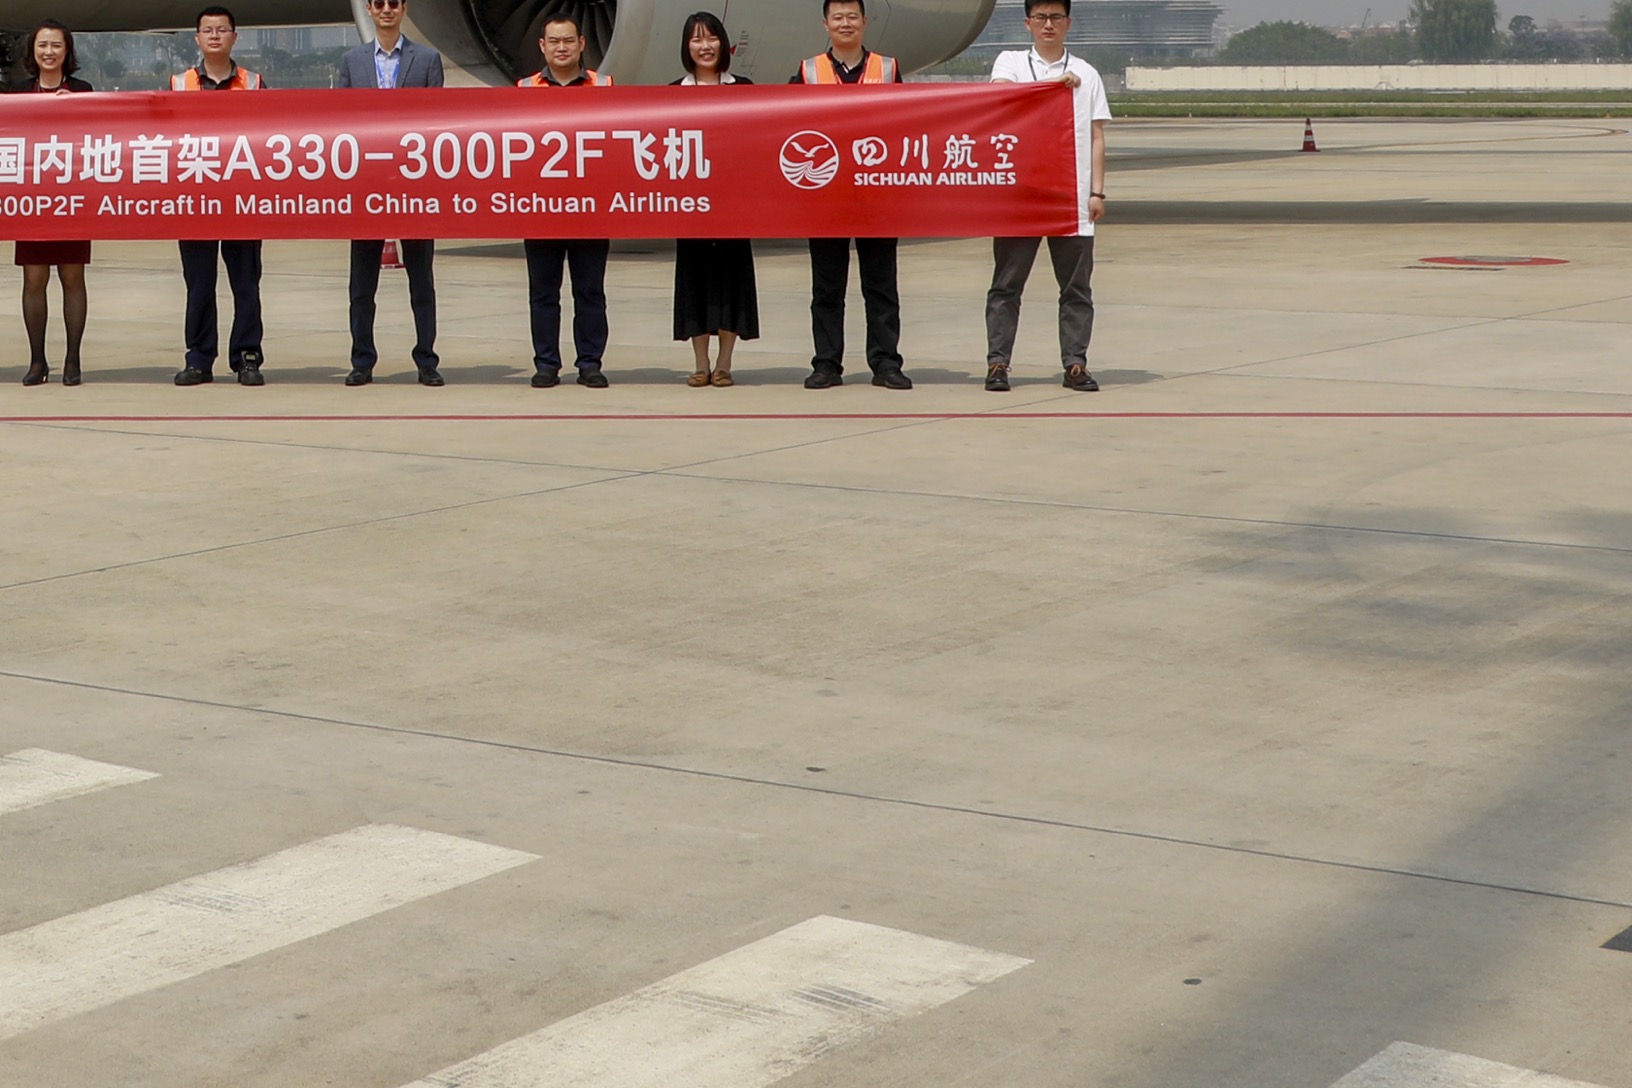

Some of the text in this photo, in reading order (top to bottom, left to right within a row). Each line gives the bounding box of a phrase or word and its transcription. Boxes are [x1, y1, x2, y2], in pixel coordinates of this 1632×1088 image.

[852, 133, 1019, 170] 四川航空
[854, 172, 1016, 186] SICHUAN AIRLINES
[97, 194, 194, 216] Aircraft
[200, 194, 221, 215] in
[235, 193, 352, 215] Mainland
[365, 193, 440, 214] China
[452, 193, 477, 213] to
[491, 192, 595, 213] Sichuan
[609, 192, 710, 213] Airlines
